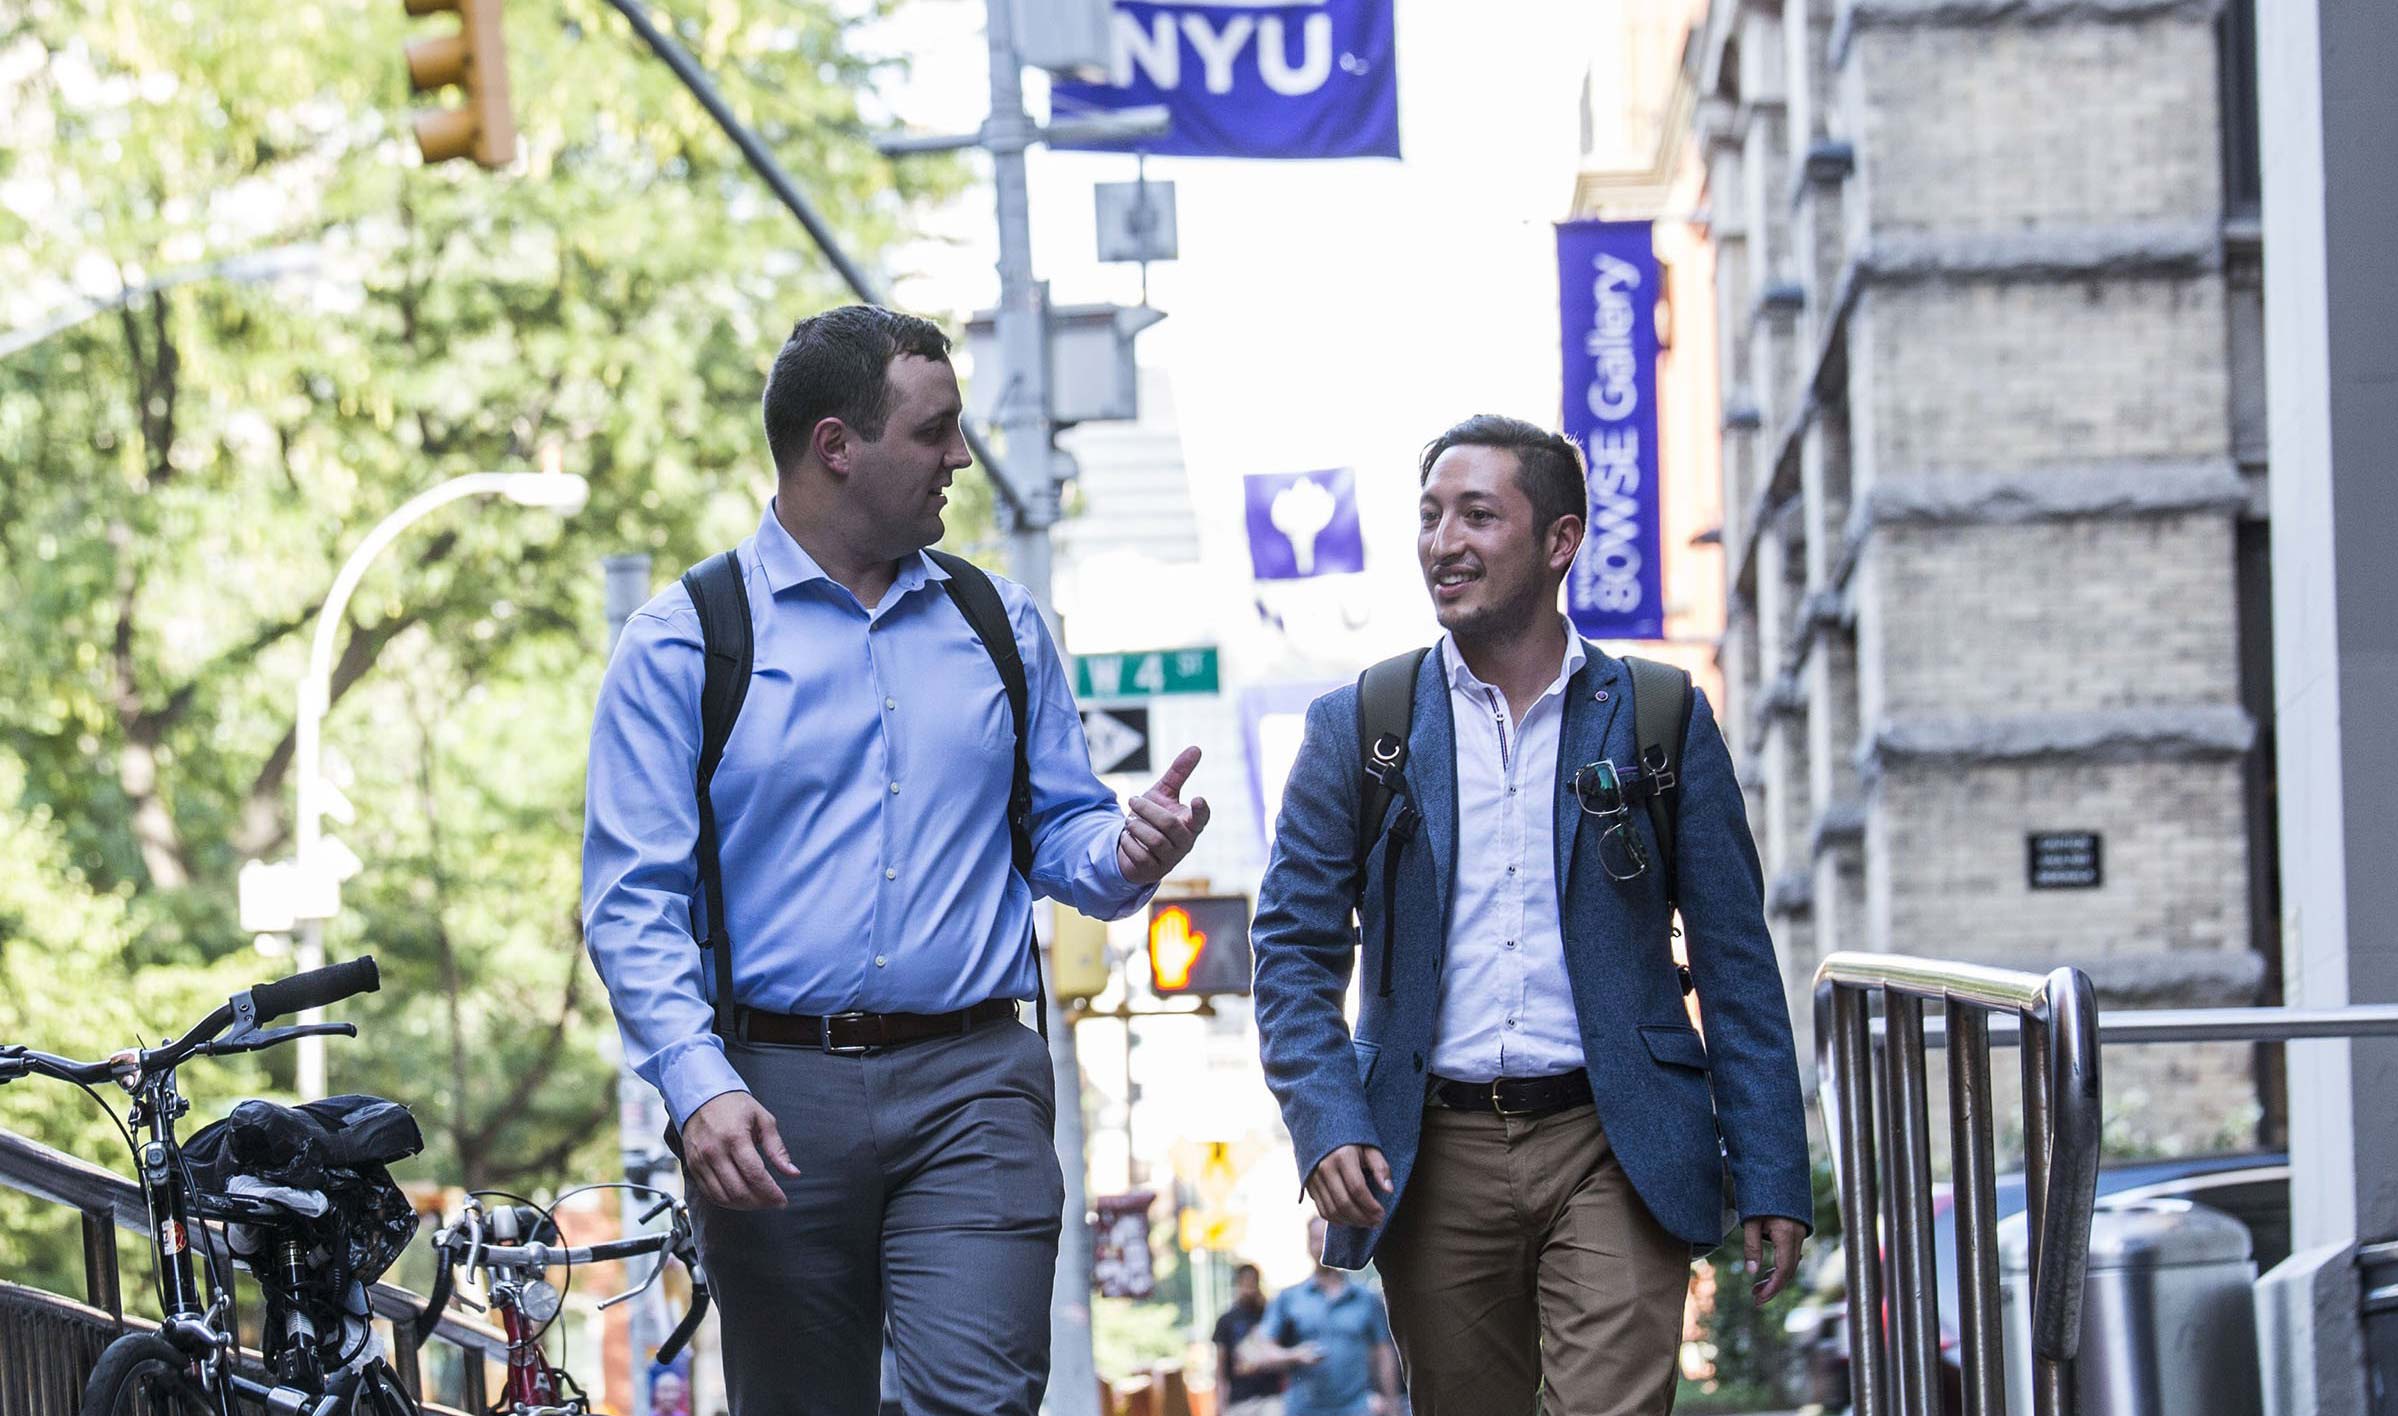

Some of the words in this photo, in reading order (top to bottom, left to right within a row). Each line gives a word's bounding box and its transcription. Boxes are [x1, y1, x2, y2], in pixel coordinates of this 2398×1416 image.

[1110, 12, 1333, 96] NYU
[1586, 253, 1641, 421] Gallery
[1087, 656, 1124, 694] W
[1134, 653, 1167, 694] 4
